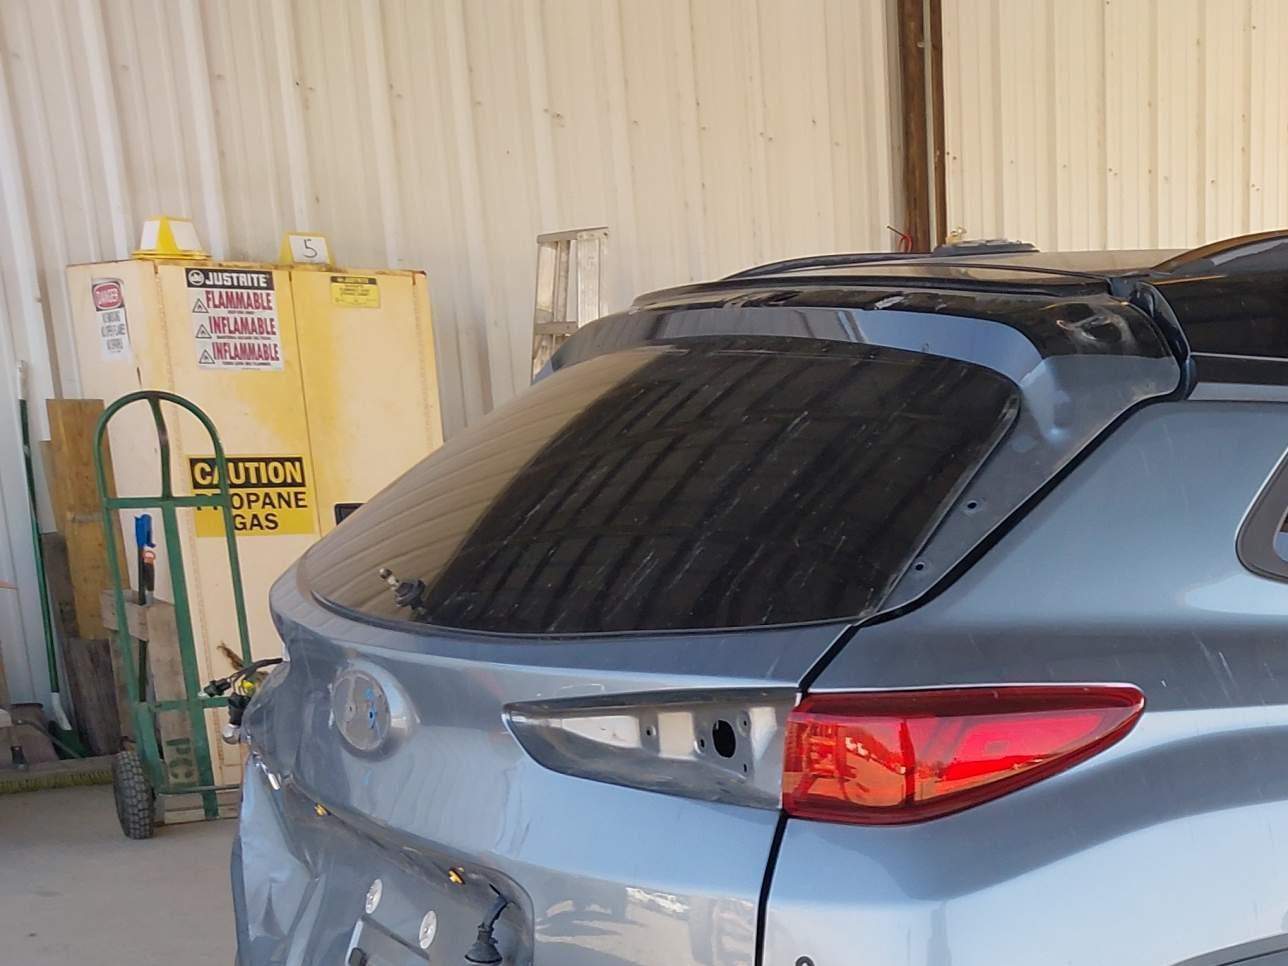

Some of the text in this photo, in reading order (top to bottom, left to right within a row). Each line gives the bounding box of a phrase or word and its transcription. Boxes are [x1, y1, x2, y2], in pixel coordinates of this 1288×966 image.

[303, 238, 318, 258] 5
[205, 271, 268, 288] JUSTRITE
[205, 290, 273, 311] FLAMMABLE
[208, 315, 277, 336] INFLAMABLE
[211, 341, 280, 362] INFLAMMABLE
[195, 491, 308, 511] OPANE
[233, 512, 279, 531] GAS
